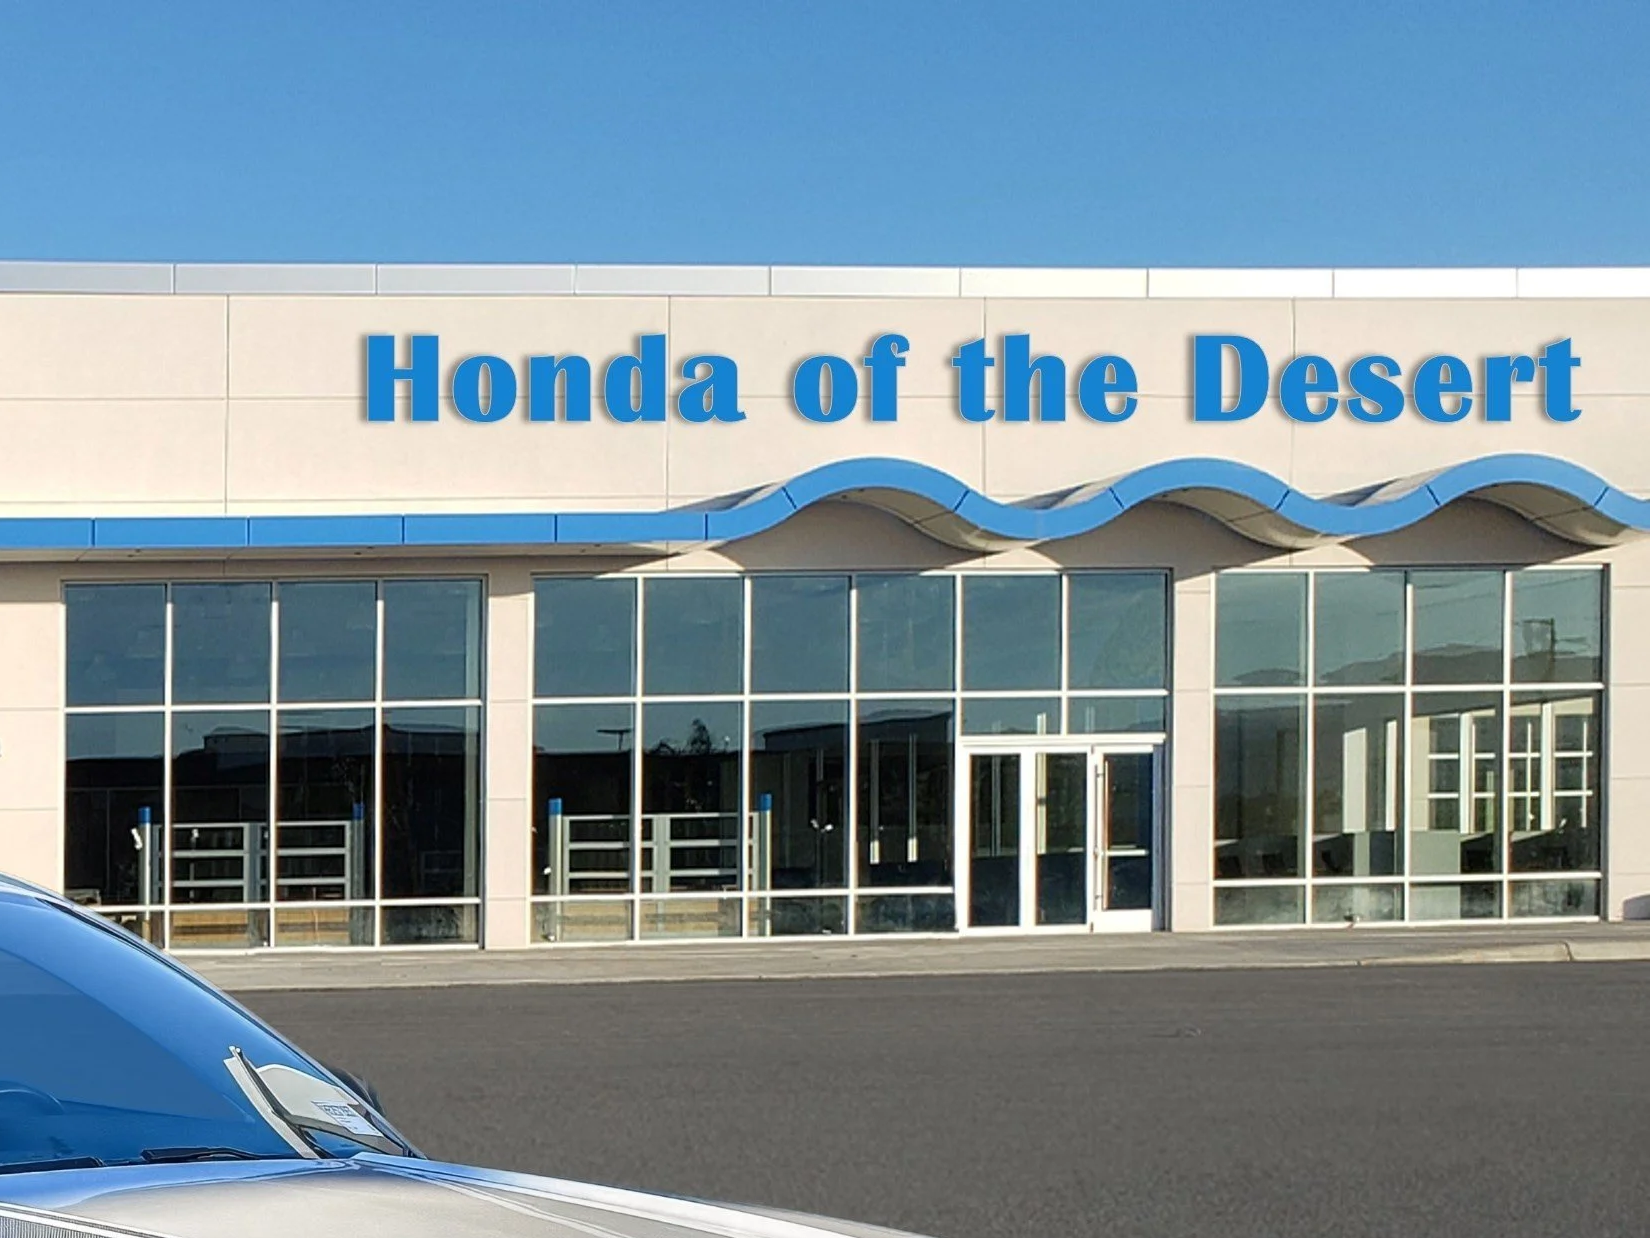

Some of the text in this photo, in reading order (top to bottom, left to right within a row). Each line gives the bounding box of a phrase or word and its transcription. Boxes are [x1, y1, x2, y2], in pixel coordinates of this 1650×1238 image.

[366, 333, 1582, 424] Honda of the Desert
